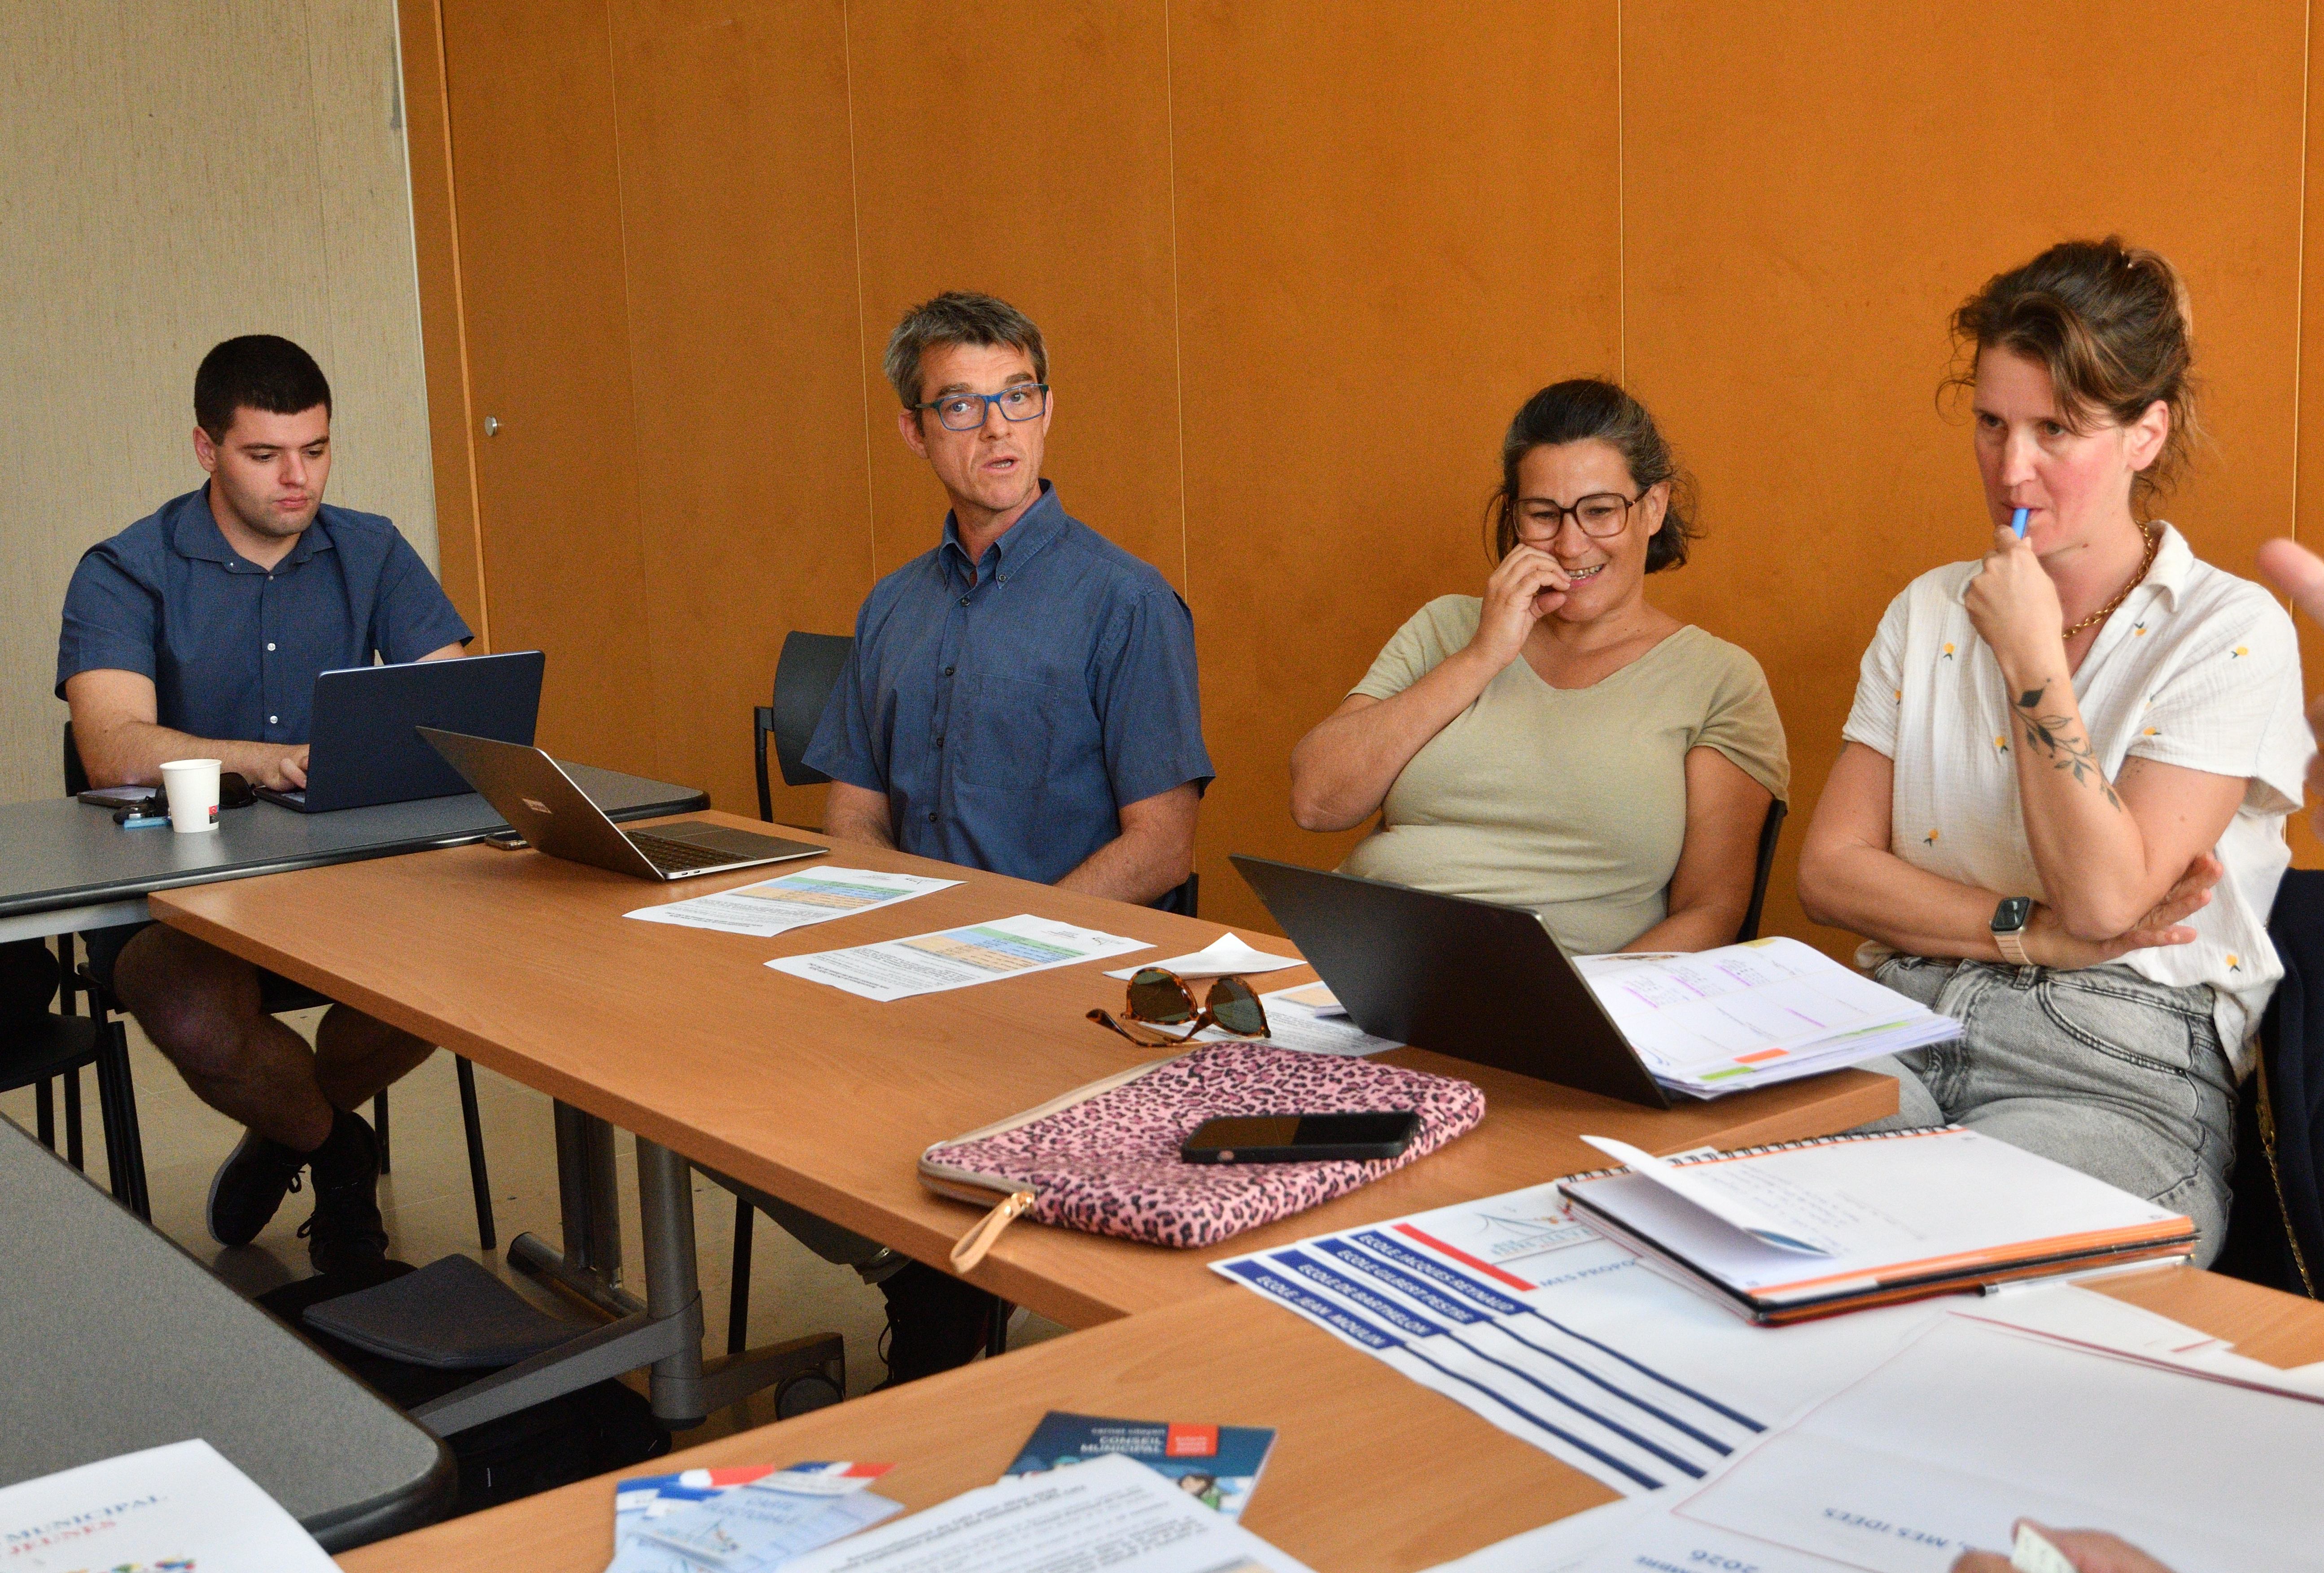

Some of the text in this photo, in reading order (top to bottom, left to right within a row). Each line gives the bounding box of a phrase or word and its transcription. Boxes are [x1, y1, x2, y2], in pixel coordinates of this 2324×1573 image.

[1358, 1234, 1402, 1258] ECOLE
[1335, 1249, 1379, 1272] ECOLE
[1577, 1258, 1636, 1278] PROPO
[1298, 1262, 1339, 1287] ECOLE
[1256, 1275, 1300, 1298] ECOLE
[1329, 1313, 1386, 1346] MOULIN
[1080, 1444, 1161, 1453] MUNICIPAL
[5, 1494, 167, 1542] MUNICIPAL
